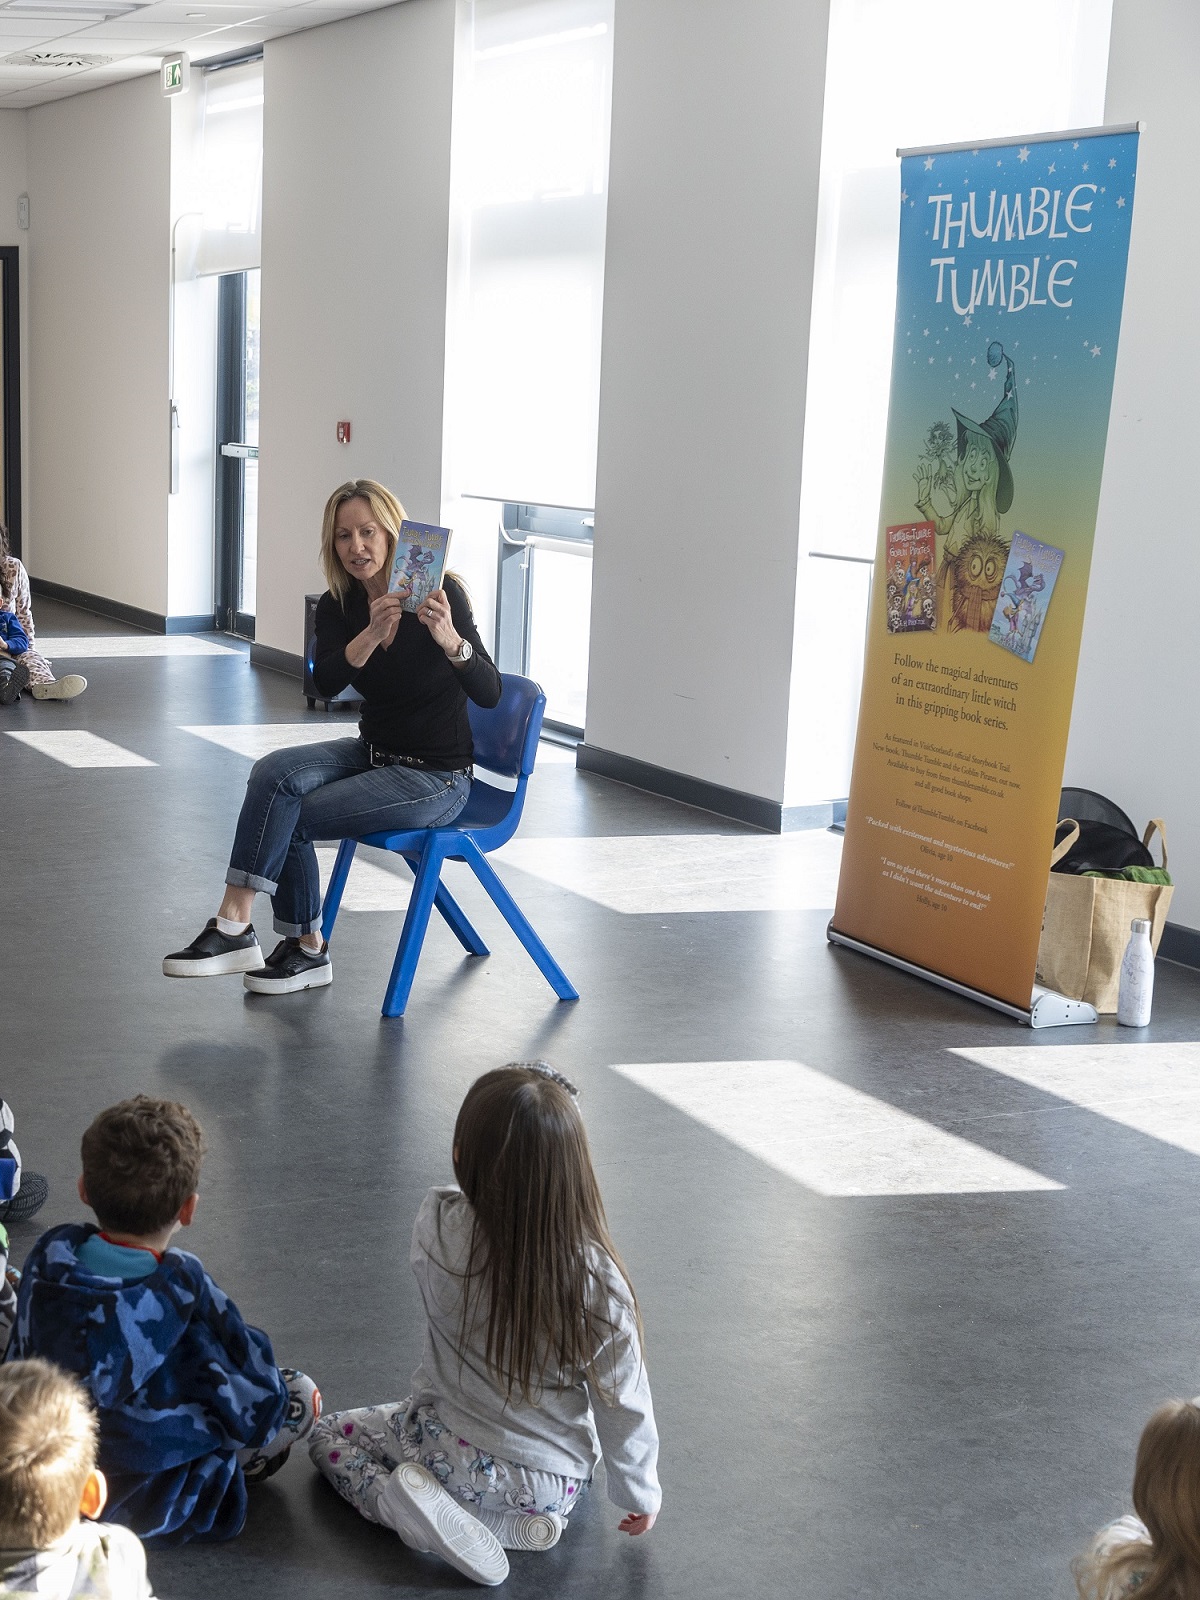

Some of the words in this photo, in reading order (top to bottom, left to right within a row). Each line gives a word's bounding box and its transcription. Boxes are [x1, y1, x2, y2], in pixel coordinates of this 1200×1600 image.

[927, 183, 1098, 249] THUMBLE
[930, 256, 1078, 316] TUMBLE
[894, 653, 924, 668] Follow
[926, 659, 939, 673] the
[941, 666, 972, 681] magical
[973, 670, 1019, 691] adventures
[891, 673, 902, 685] of
[903, 678, 913, 688] an
[916, 683, 970, 703] extraordinary
[971, 689, 992, 706] little
[993, 697, 1016, 712] witch
[896, 693, 905, 705] in
[908, 695, 922, 709] this
[924, 701, 959, 722] gripping
[961, 707, 982, 724] book
[983, 716, 1008, 730] series.
[873, 742, 884, 751] New
[902, 749, 923, 761] Thumble
[924, 755, 942, 766] Tumble
[961, 766, 980, 777] Goblin
[892, 734, 913, 746] featured
[954, 752, 971, 762] official
[972, 755, 998, 769] Storybook
[887, 759, 909, 770] Available
[916, 766, 925, 776] buy
[926, 769, 938, 779] from
[939, 772, 950, 782] from
[945, 787, 956, 797] book
[895, 799, 911, 809] Follow
[964, 820, 988, 834] Facebook
[889, 825, 902, 833] with
[902, 829, 932, 843] excitement
[944, 843, 976, 858] mysterious
[887, 860, 896, 868] am
[903, 865, 916, 875] glad
[936, 877, 949, 886] more
[951, 882, 964, 892] than
[976, 890, 991, 901] book
[893, 872, 909, 884] didn't
[910, 880, 924, 889] want
[924, 883, 933, 893] the
[934, 888, 961, 903] adventure
[932, 902, 940, 910] age
